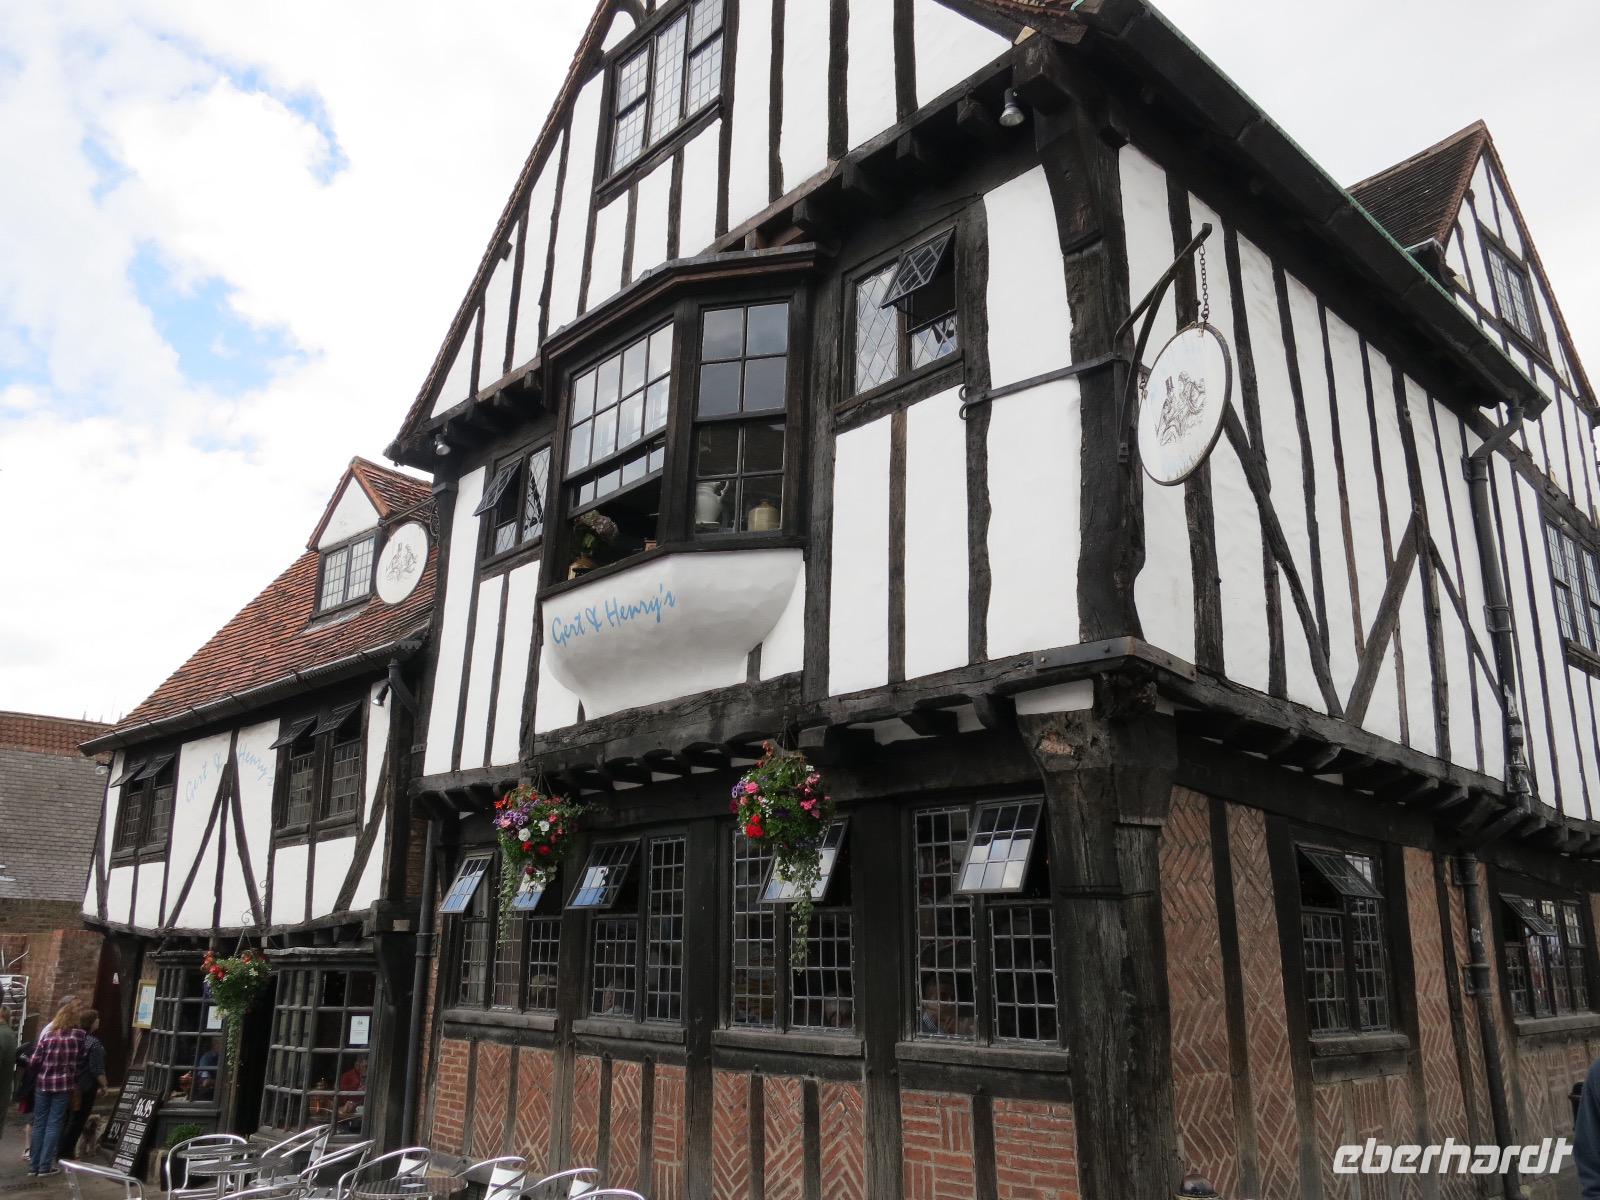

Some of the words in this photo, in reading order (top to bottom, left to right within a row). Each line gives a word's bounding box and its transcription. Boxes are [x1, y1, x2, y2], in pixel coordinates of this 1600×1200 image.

[552, 613, 585, 646] Gert
[586, 606, 603, 633] &
[605, 584, 676, 628] Henry's
[187, 760, 208, 803] Gert
[134, 1098, 155, 1118] £6.95
